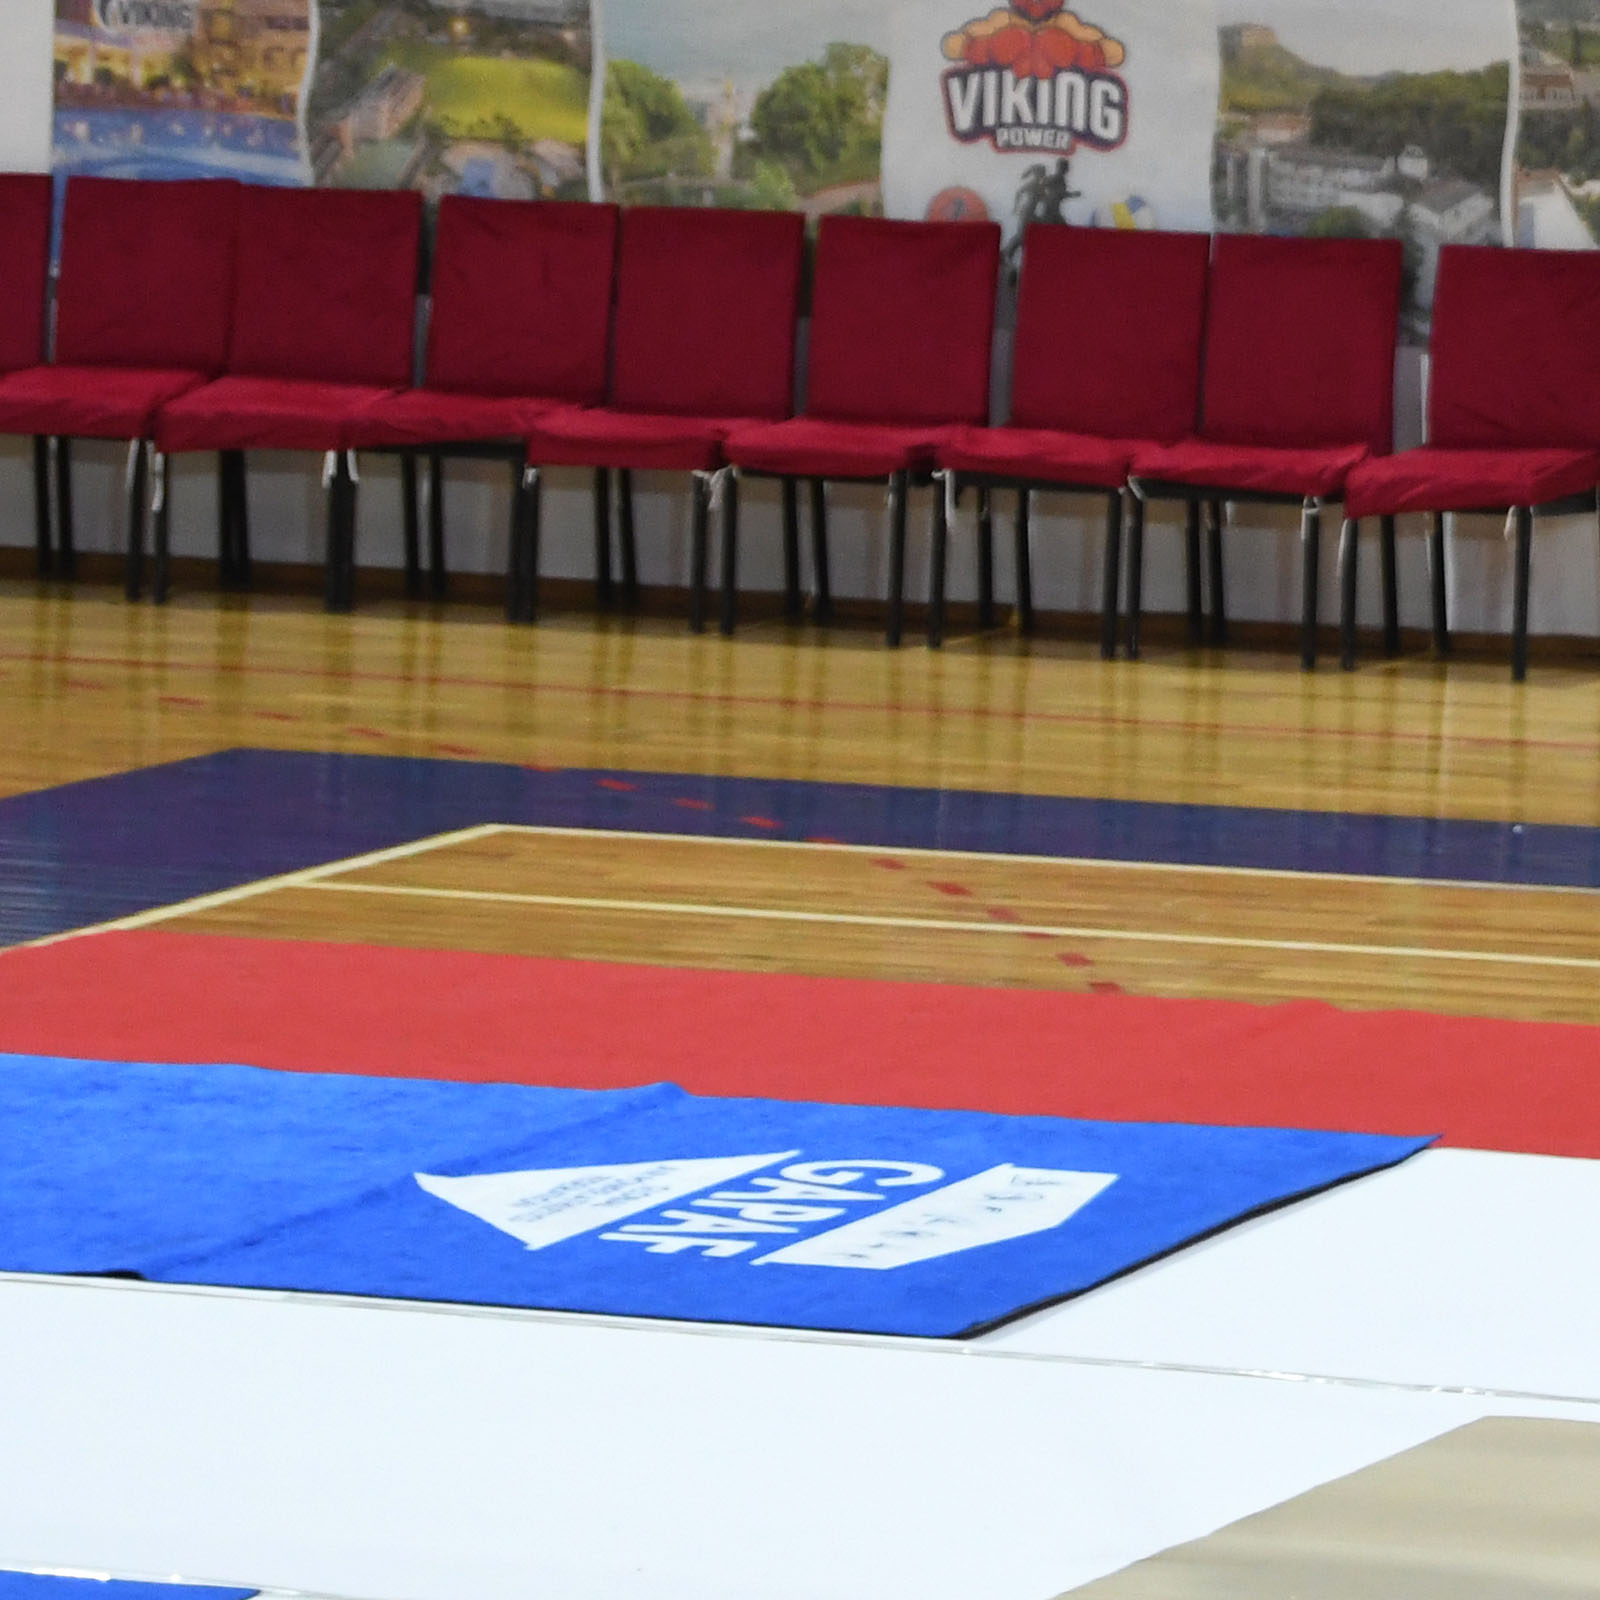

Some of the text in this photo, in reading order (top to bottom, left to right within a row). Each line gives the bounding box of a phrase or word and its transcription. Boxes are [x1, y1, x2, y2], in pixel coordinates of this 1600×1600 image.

[116, 0, 194, 30] VIKING
[947, 69, 1123, 142] VIKING
[995, 126, 1072, 150] POWER
[597, 1158, 946, 1259] GAPAF
